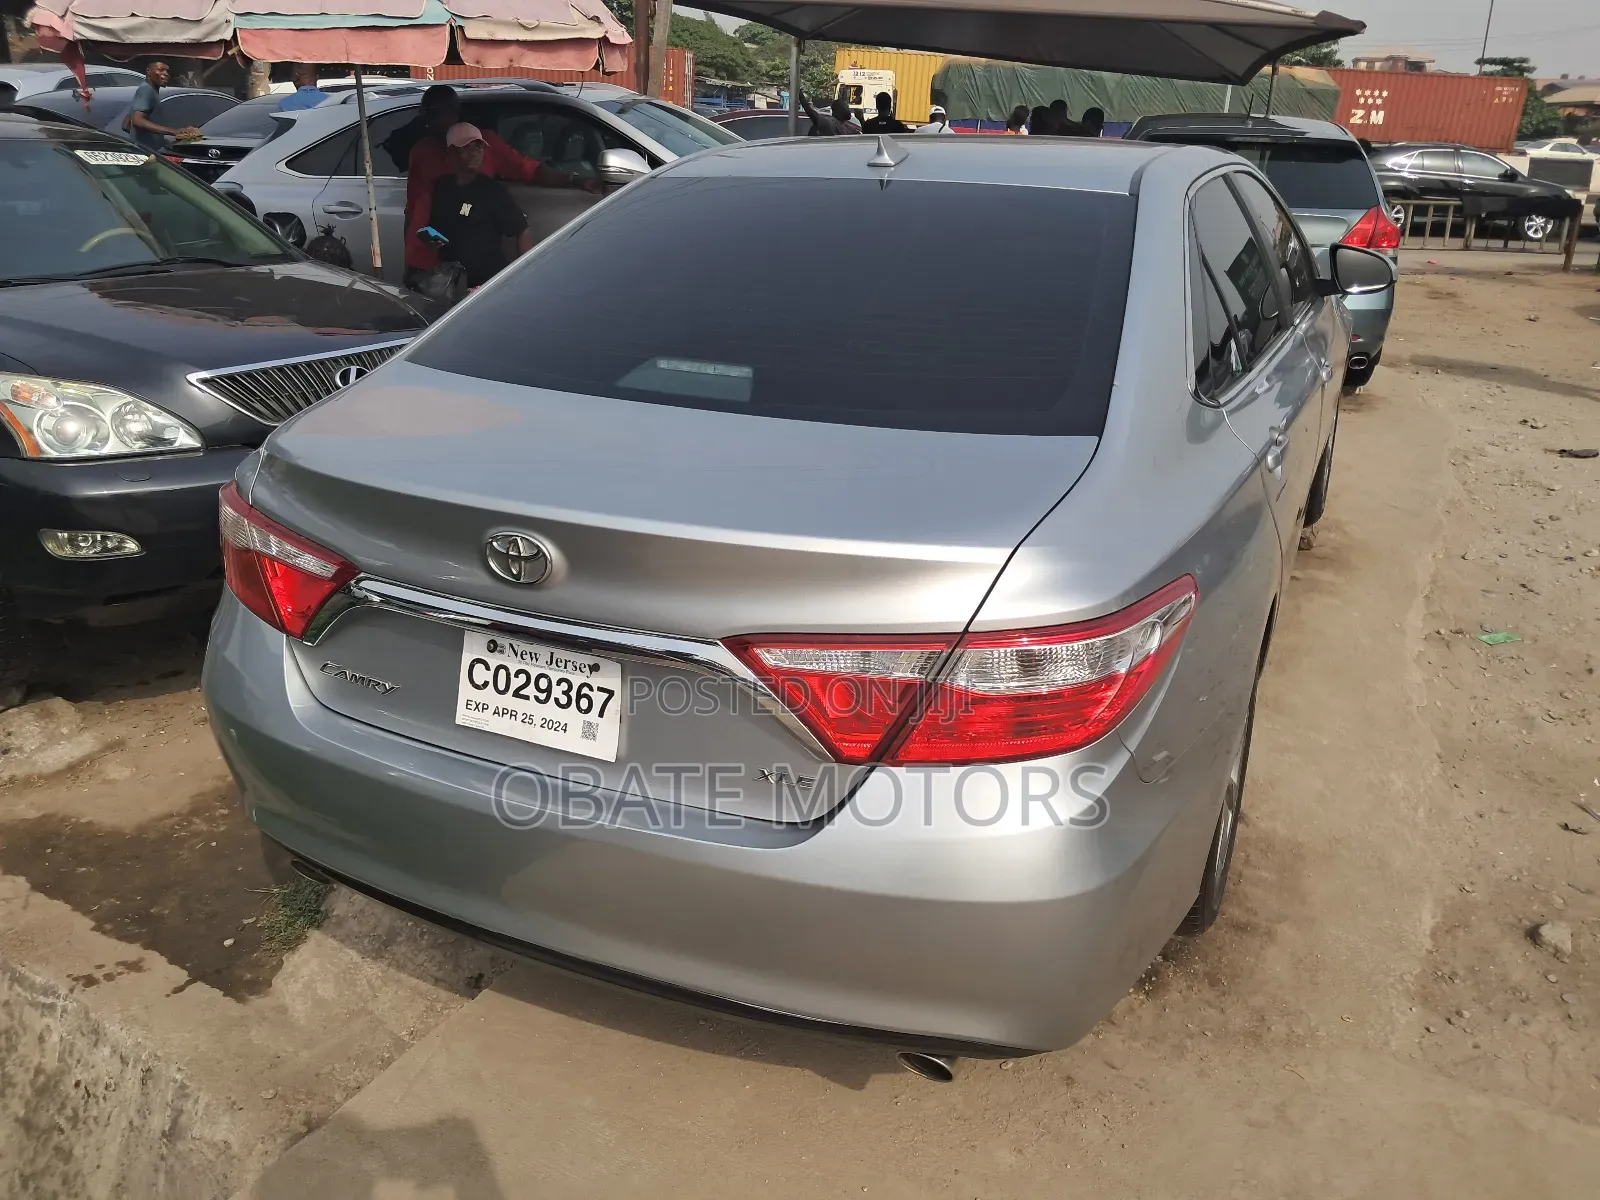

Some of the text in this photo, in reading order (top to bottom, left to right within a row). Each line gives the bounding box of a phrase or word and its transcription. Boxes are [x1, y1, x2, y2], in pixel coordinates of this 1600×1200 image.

[319, 660, 401, 696] CAMRY
[508, 642, 542, 664] New
[545, 651, 595, 679] Jersey
[467, 657, 615, 719] C029367
[465, 699, 489, 713] EXP
[492, 705, 518, 721] APR
[521, 712, 536, 729] 25,
[540, 717, 569, 734] 2024
